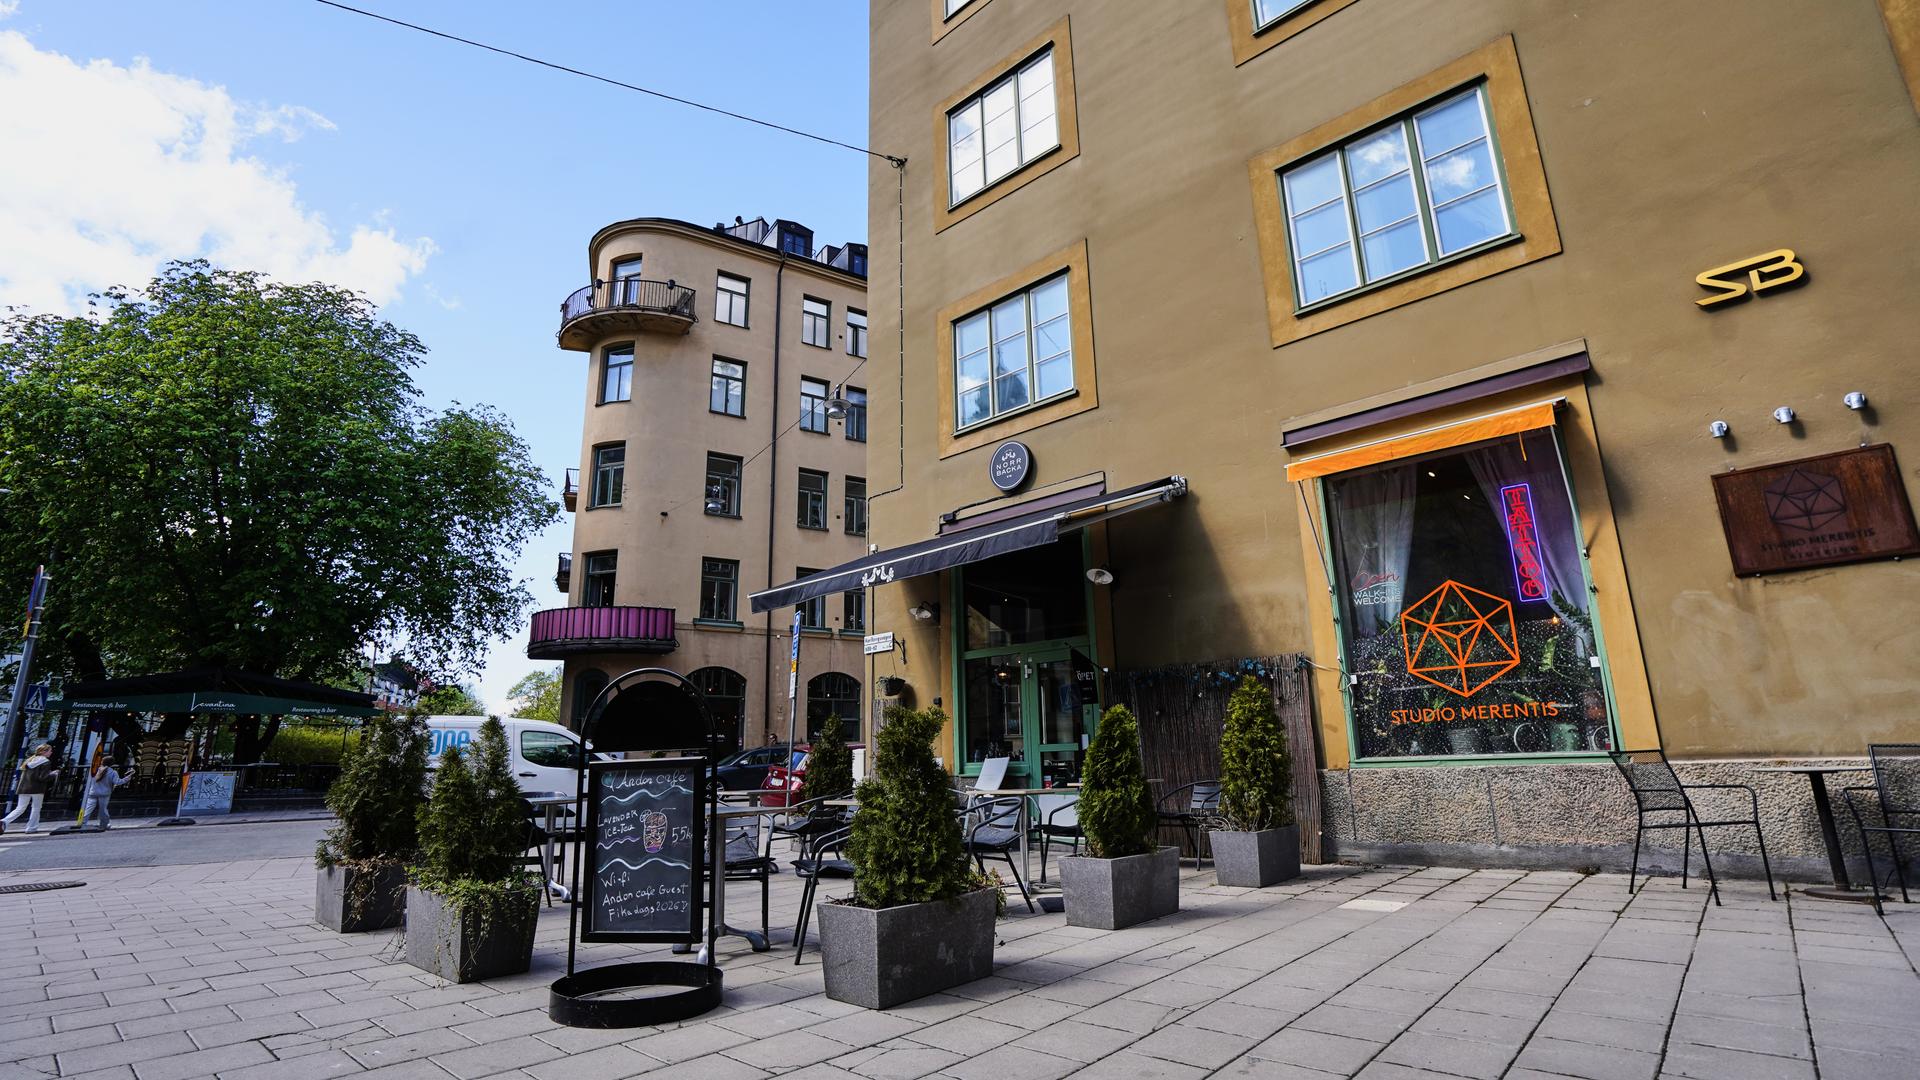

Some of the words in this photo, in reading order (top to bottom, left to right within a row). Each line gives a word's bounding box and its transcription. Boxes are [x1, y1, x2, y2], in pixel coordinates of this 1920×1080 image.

[1695, 248, 1804, 306] SB
[996, 458, 1022, 470] NORR
[996, 465, 1022, 476] BACKA
[1505, 487, 1545, 597] TATTOO
[1353, 595, 1402, 605] WELCOME
[72, 701, 108, 709] Restaurang
[190, 692, 236, 712] Levantina
[291, 706, 321, 714] Restaurang
[1391, 707, 1456, 725] STUDIO
[1460, 701, 1559, 721] MERENTIS
[597, 810, 638, 828] LAVENDER
[602, 891, 634, 907] Andon
[658, 882, 689, 895] Guest
